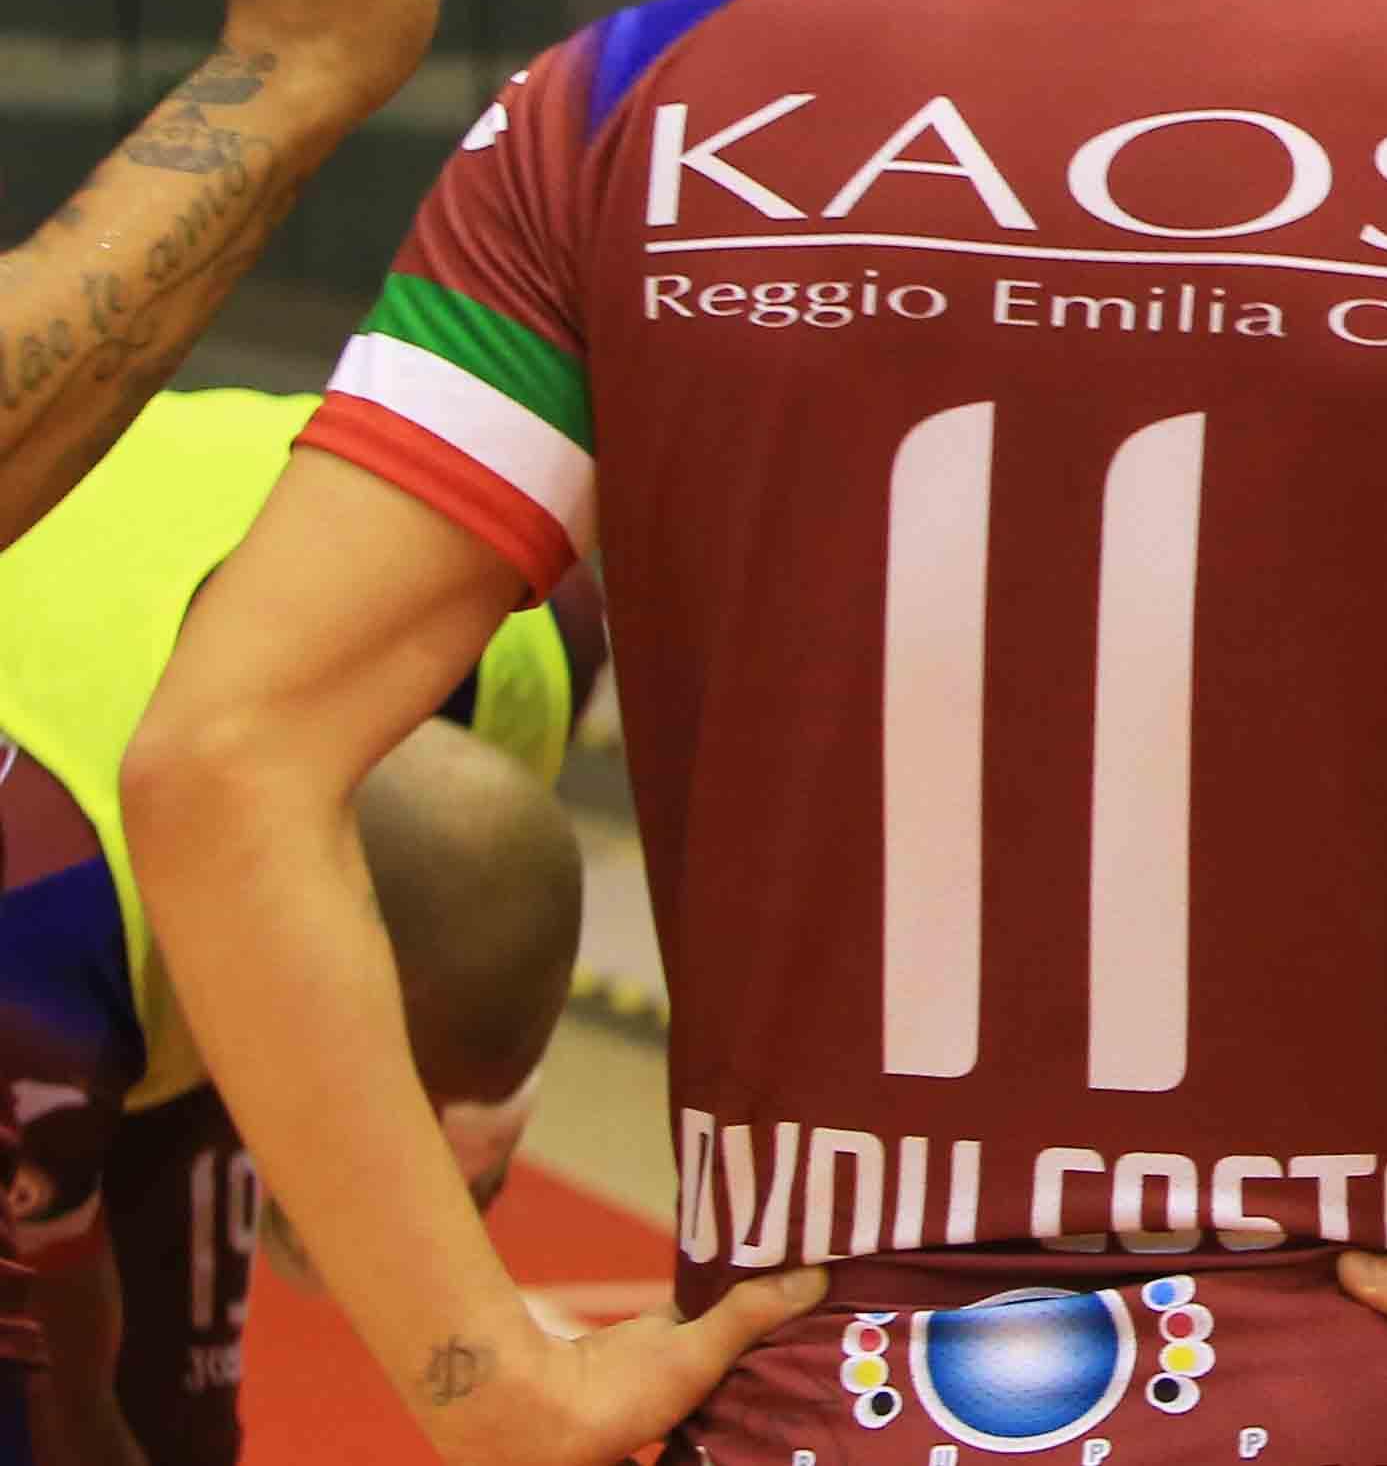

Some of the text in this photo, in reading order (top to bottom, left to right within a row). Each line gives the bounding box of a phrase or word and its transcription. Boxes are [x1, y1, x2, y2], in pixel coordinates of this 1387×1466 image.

[644, 269, 947, 328] Reggio
[993, 273, 1284, 339] Emilia
[883, 400, 1206, 1092] 11
